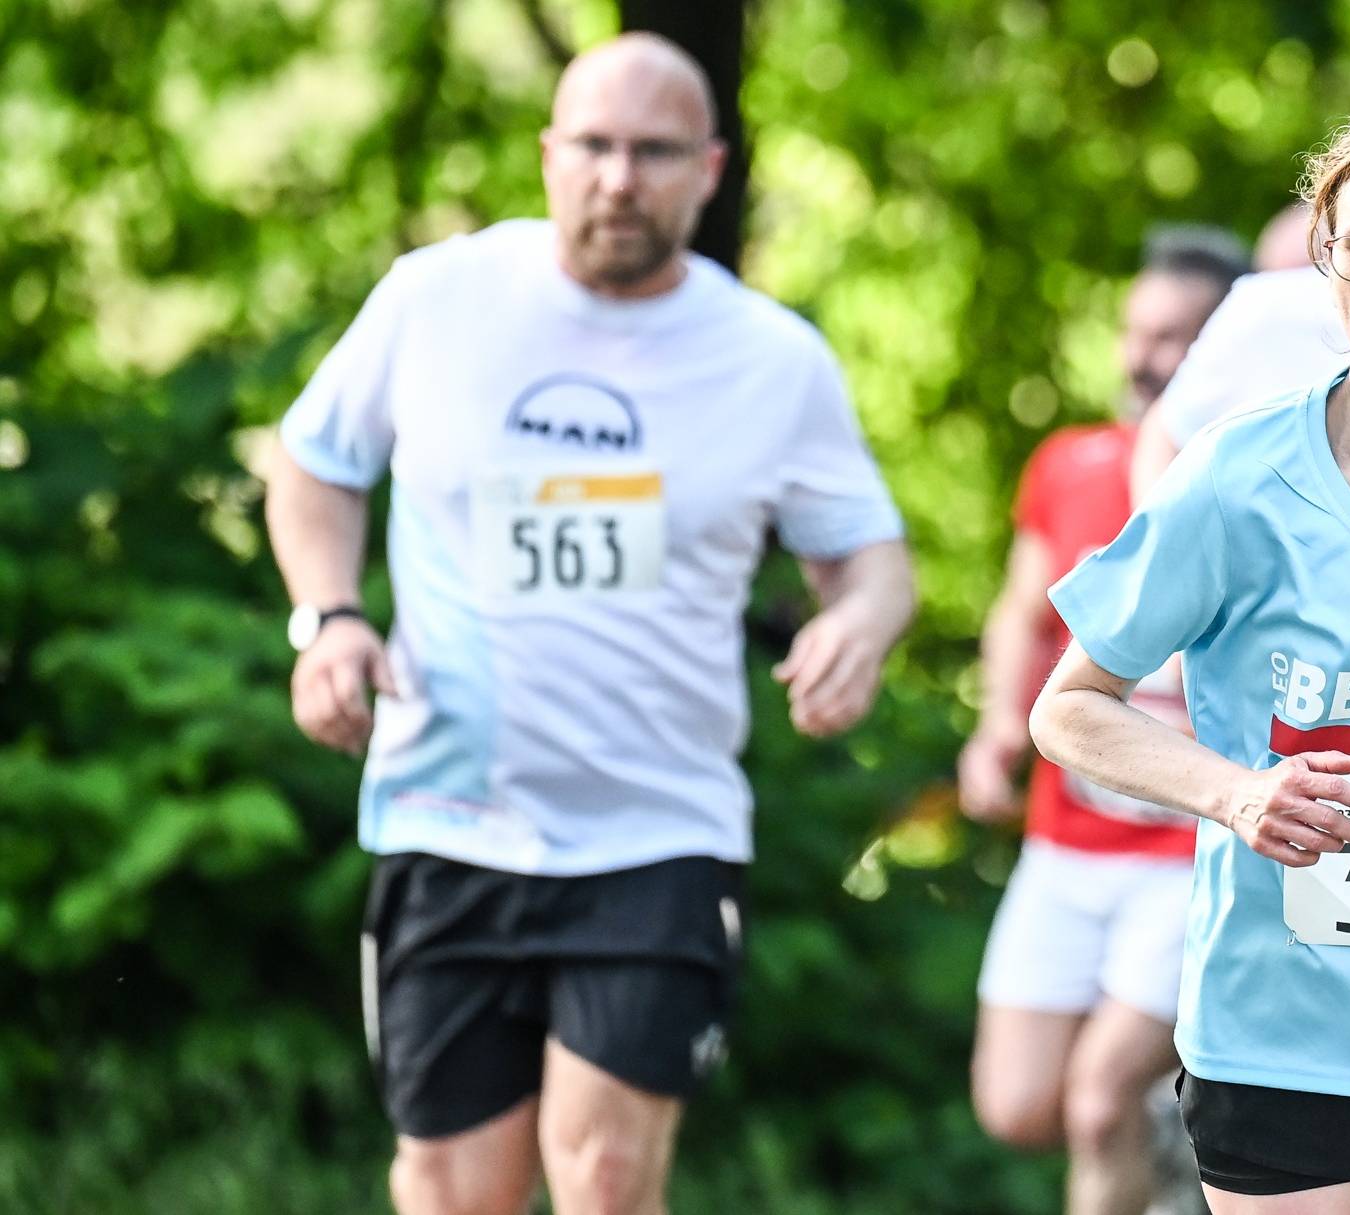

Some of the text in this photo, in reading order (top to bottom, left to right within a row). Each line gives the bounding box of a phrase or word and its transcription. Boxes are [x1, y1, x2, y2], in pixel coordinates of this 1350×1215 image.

[517, 416, 628, 450] MAN
[511, 516, 624, 592] 563
[1271, 651, 1289, 713] LEO
